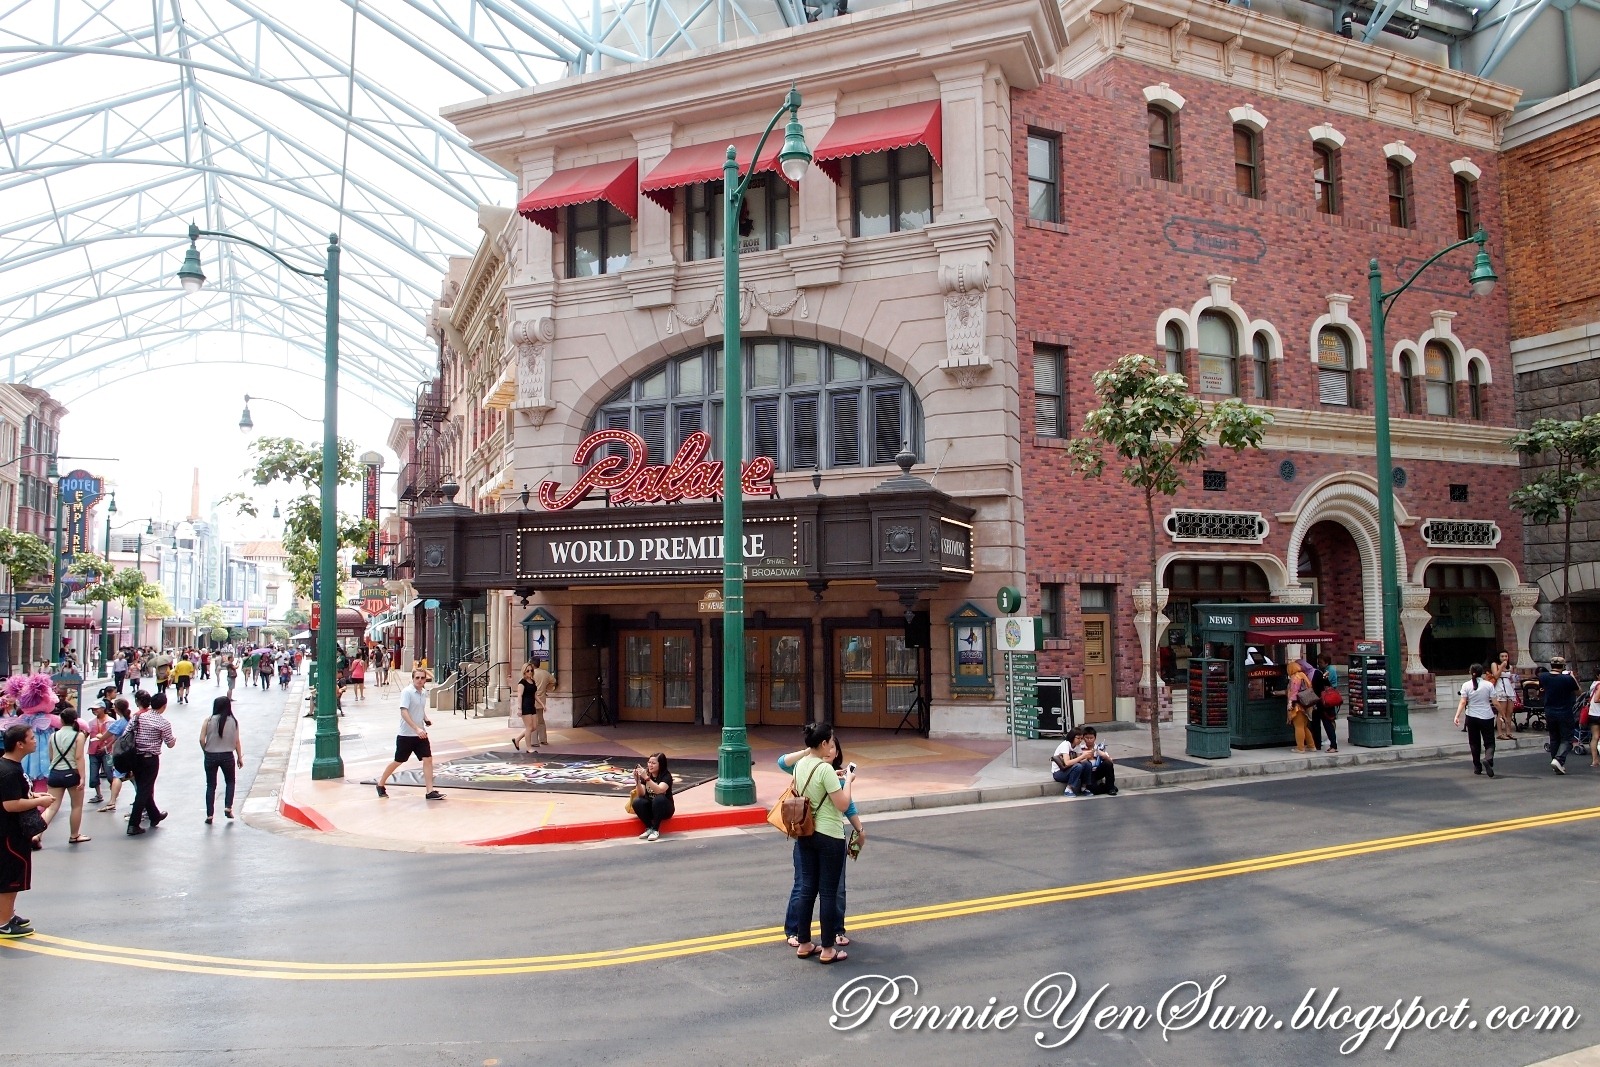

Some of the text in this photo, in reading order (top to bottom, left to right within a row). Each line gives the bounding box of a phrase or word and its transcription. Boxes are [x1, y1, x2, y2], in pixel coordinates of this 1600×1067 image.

[539, 429, 774, 510] Palae
[61, 479, 98, 494] HOTEL
[549, 539, 634, 563] WORLD
[751, 568, 801, 577] BROADWAY
[362, 589, 388, 597] OUTFITTERS
[367, 600, 383, 613] LTD
[1208, 615, 1233, 625] NEWS
[1254, 616, 1299, 624] NEWS STAND
